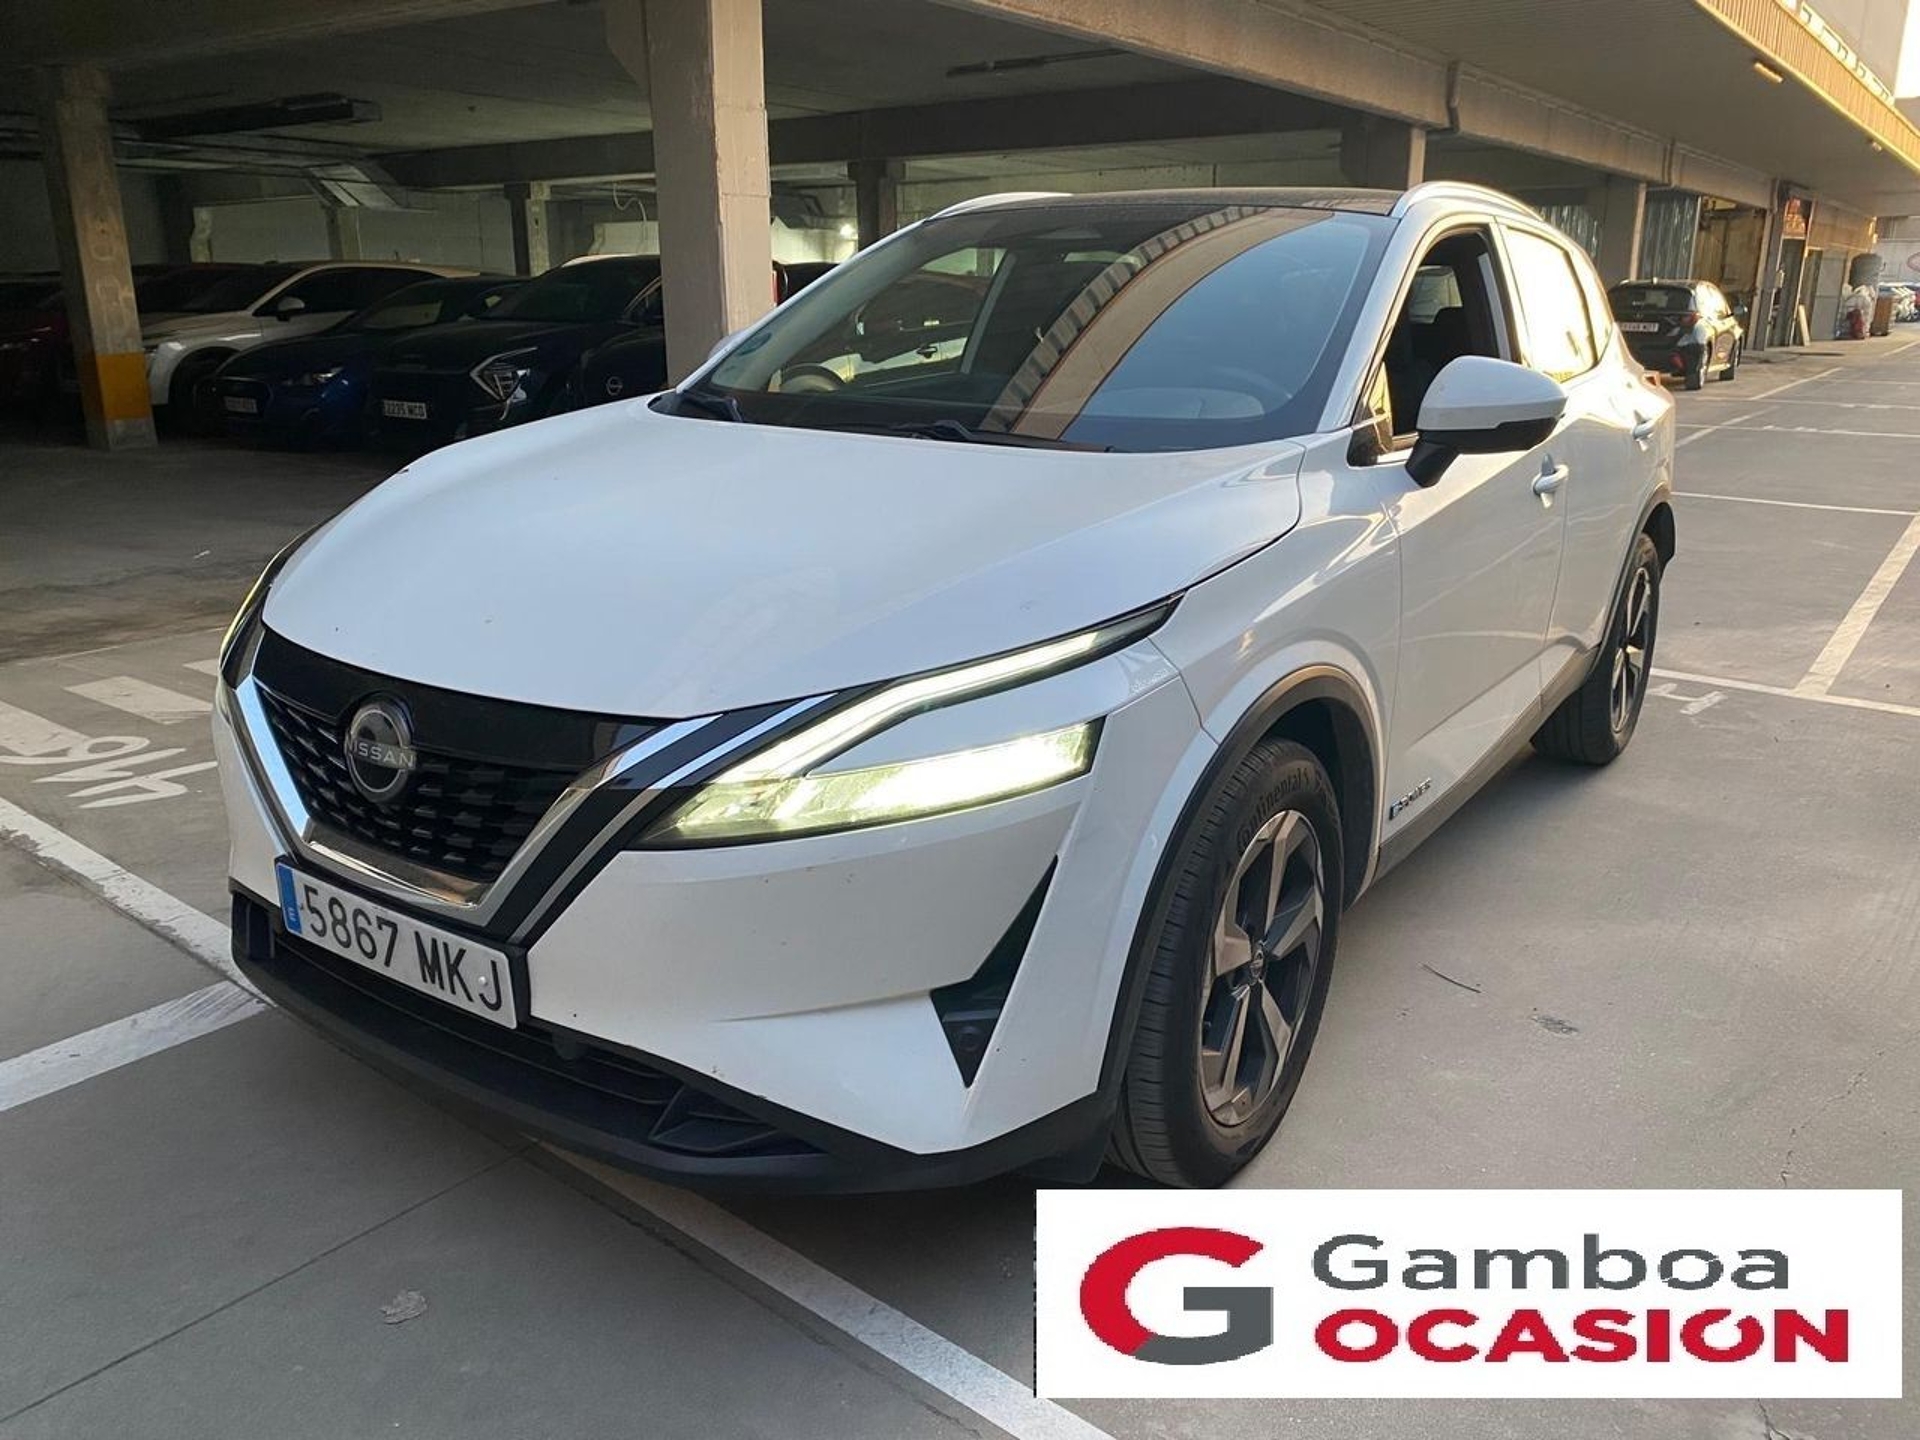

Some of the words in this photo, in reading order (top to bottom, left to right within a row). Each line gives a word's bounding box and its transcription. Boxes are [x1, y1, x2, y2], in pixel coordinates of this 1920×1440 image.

[344, 733, 414, 768] NISSAN
[303, 884, 399, 968] 5867
[414, 930, 503, 1012] MKJ
